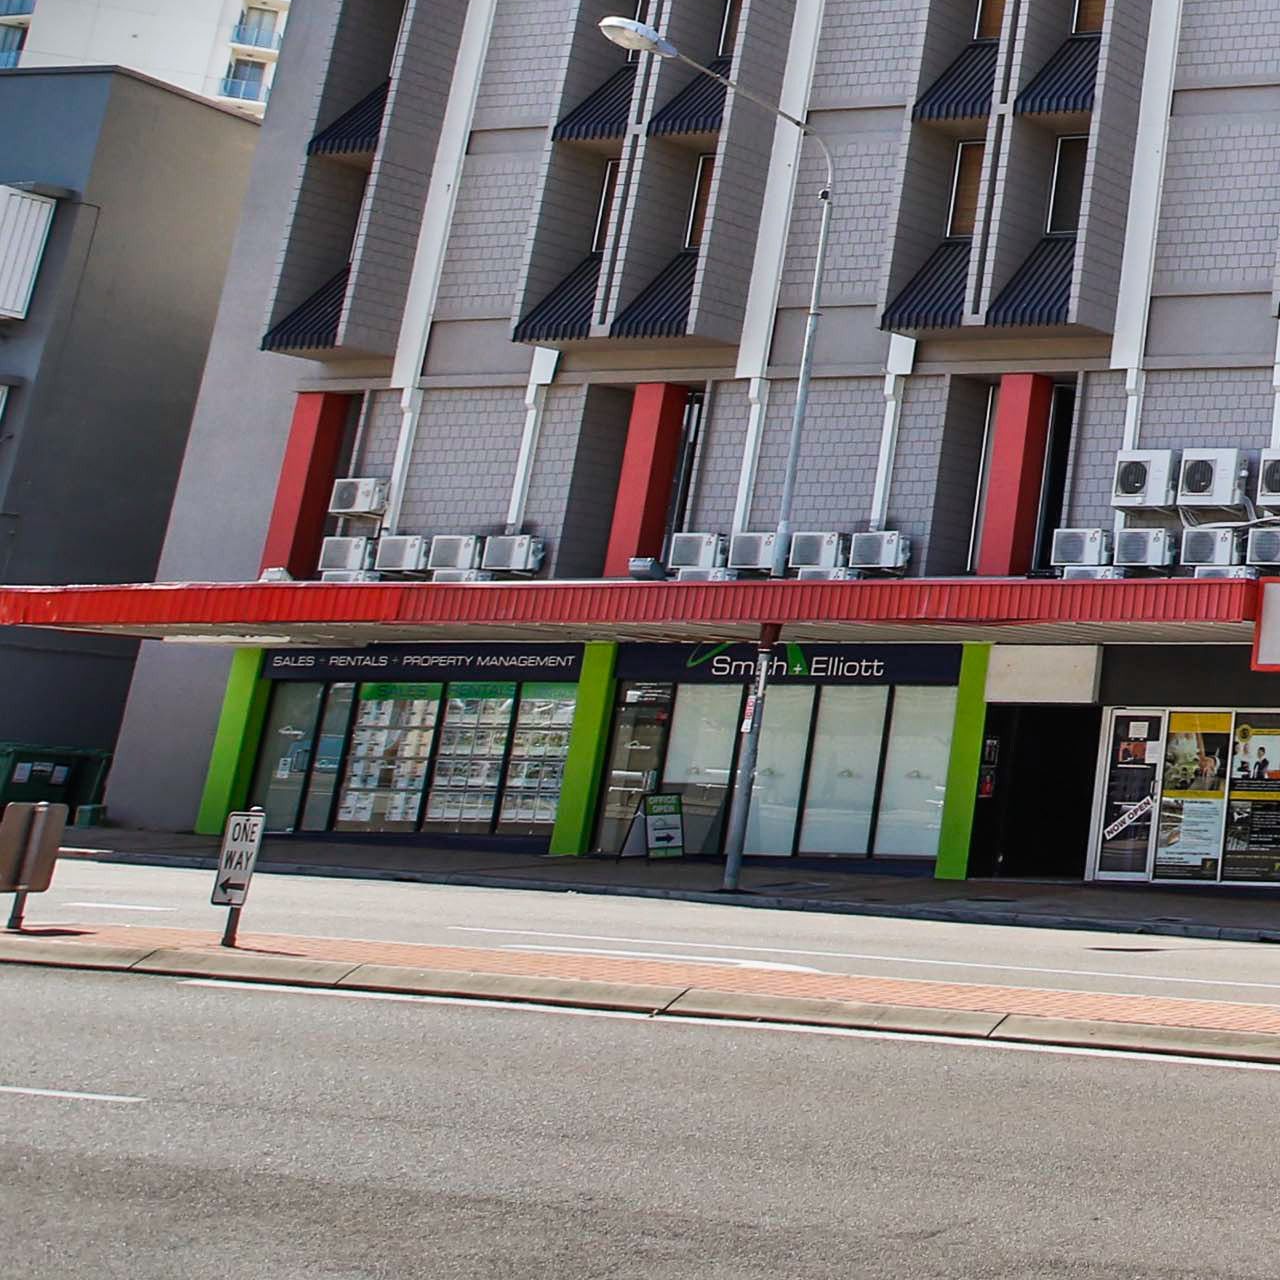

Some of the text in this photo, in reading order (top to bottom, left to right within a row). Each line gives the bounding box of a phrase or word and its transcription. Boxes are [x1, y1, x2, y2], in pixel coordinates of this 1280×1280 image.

[272, 656, 315, 667] SALES
[329, 656, 388, 667] RENTALS
[402, 655, 473, 667] PROPERTY
[476, 655, 576, 667] MANAGEMENT
[711, 655, 787, 676] Smh
[810, 656, 884, 676] Elliott
[1106, 799, 1152, 837] NOW OPEN
[232, 822, 260, 843] ONE
[224, 850, 253, 870] WAY
